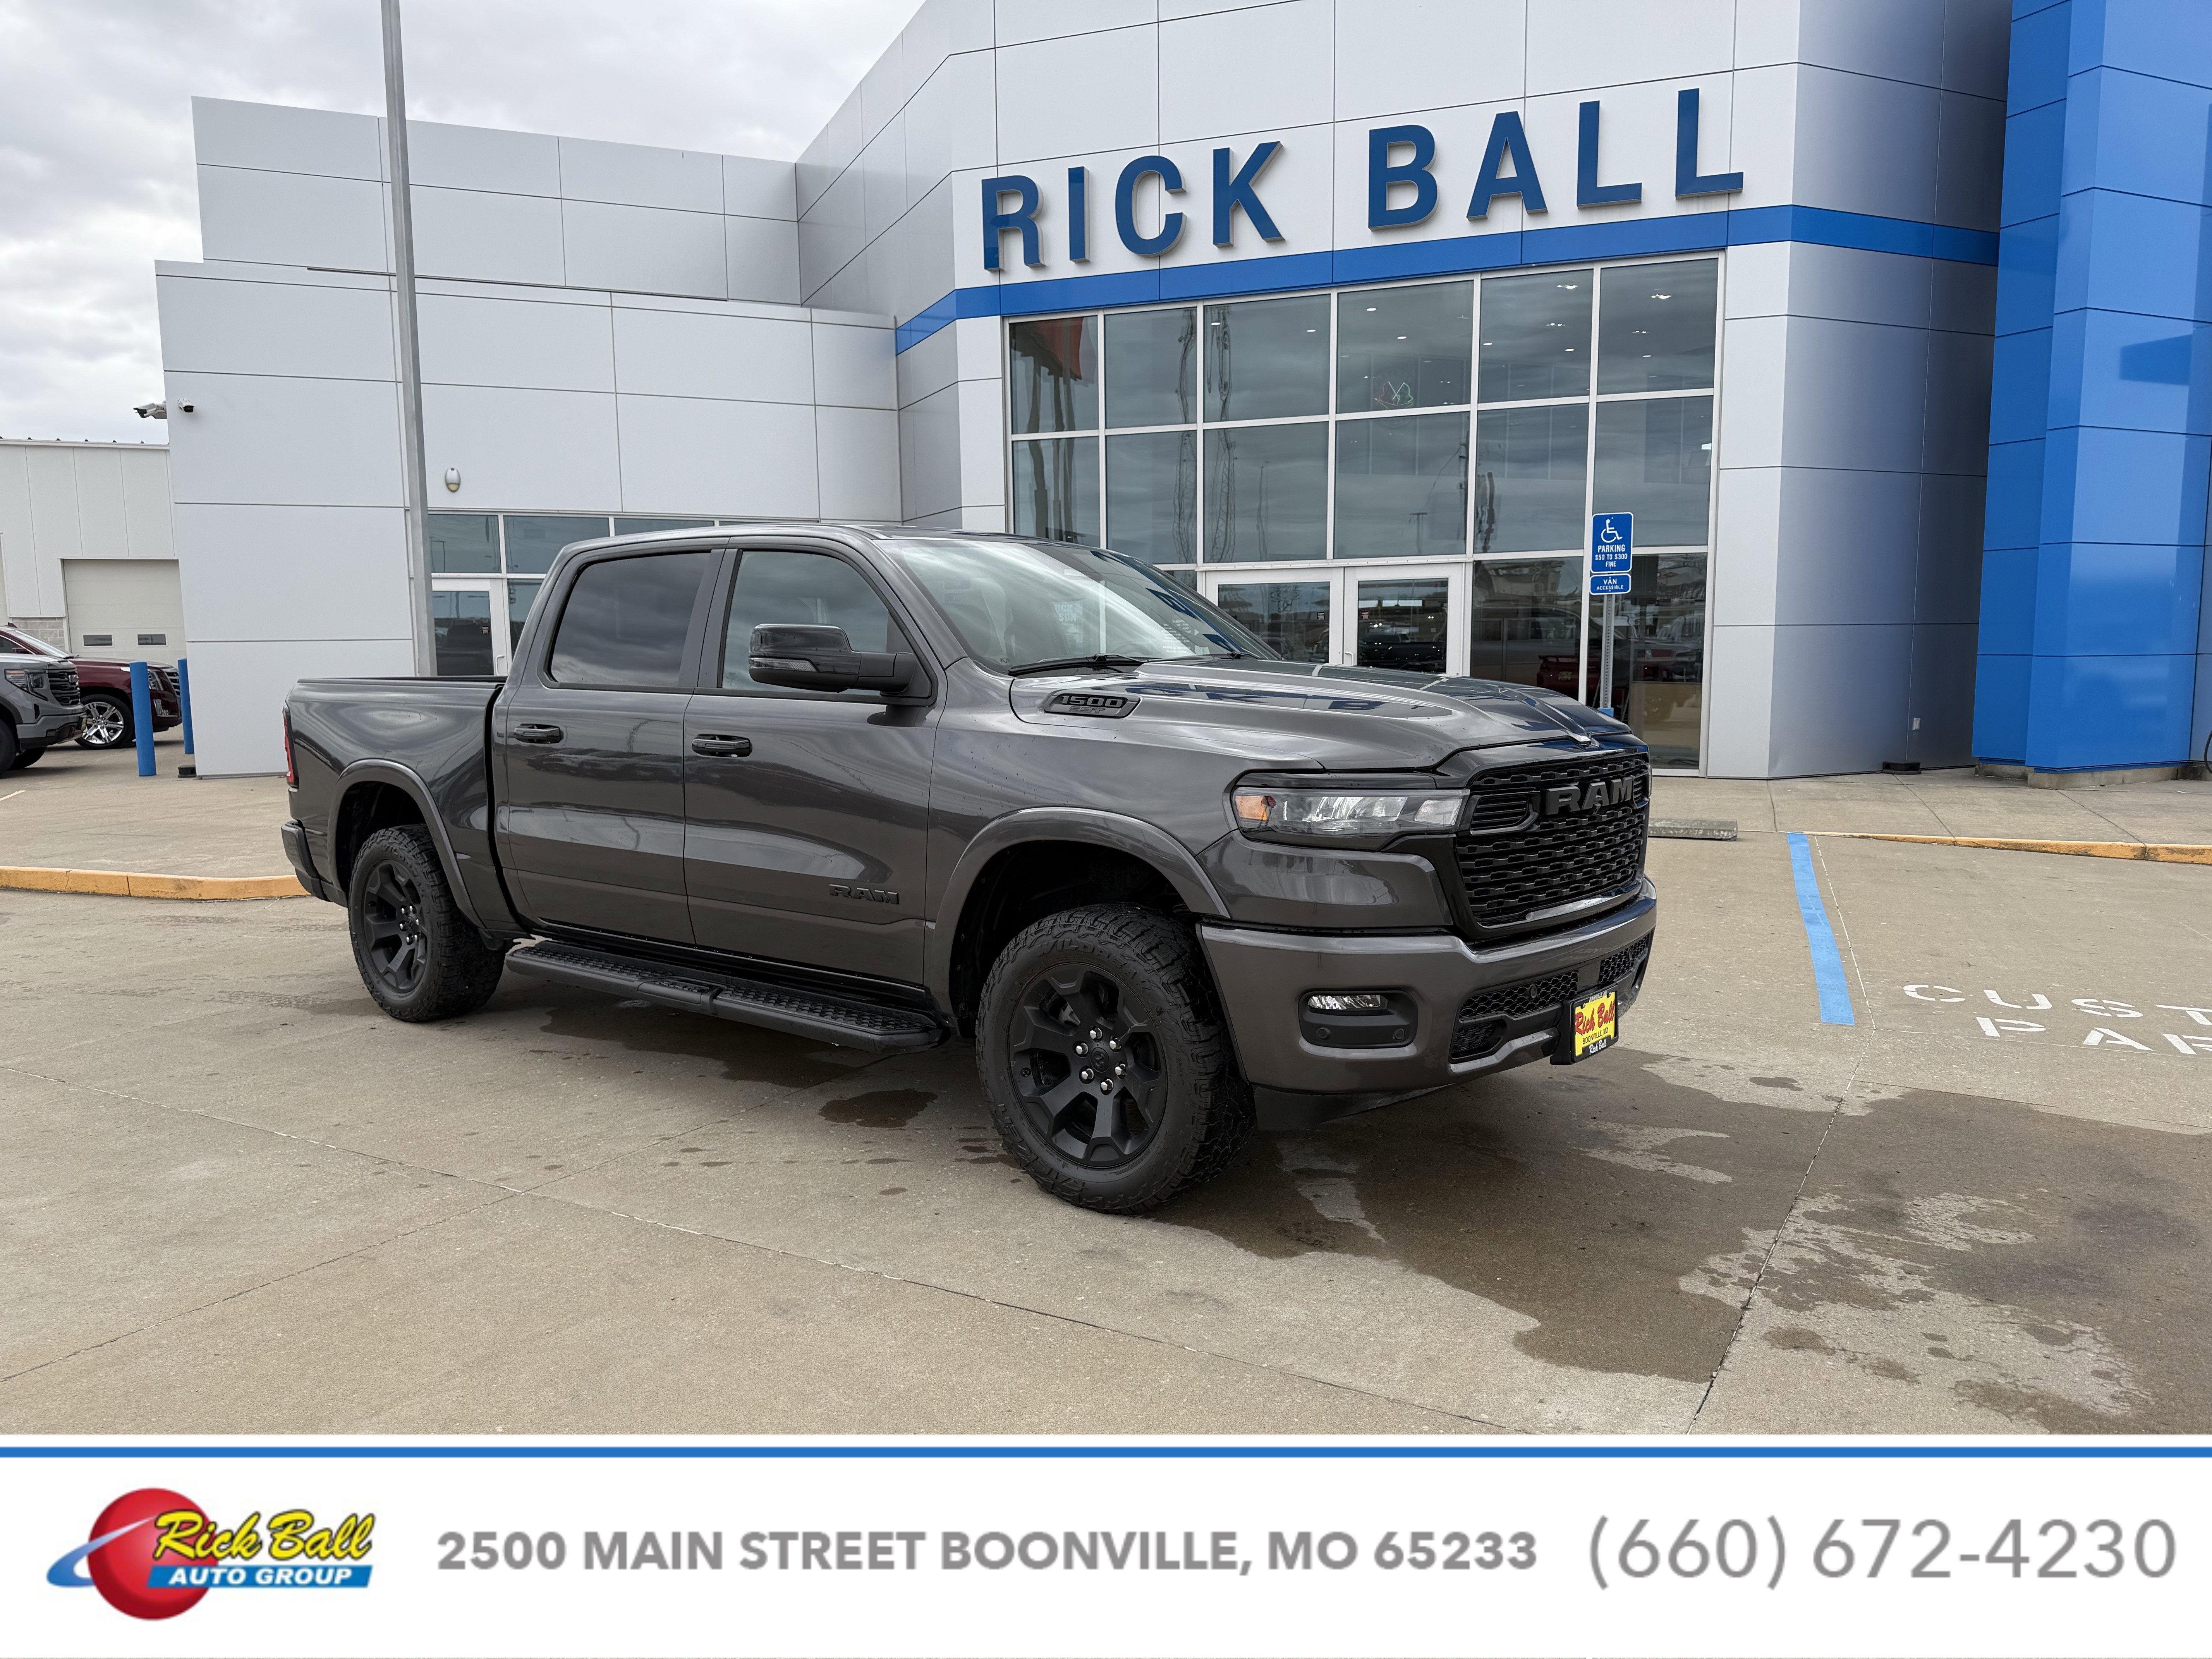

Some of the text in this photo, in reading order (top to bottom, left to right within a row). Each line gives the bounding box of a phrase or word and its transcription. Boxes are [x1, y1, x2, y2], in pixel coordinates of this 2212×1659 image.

[981, 88, 1744, 271] RICK BALL
[1597, 544, 1625, 553] PARKING
[1061, 696, 1123, 708] 1500
[1546, 775, 1634, 815] RAM
[829, 884, 899, 905] RAM
[1575, 1000, 1615, 1036] Rick Ball
[1589, 1038, 1607, 1055] Rick Ball
